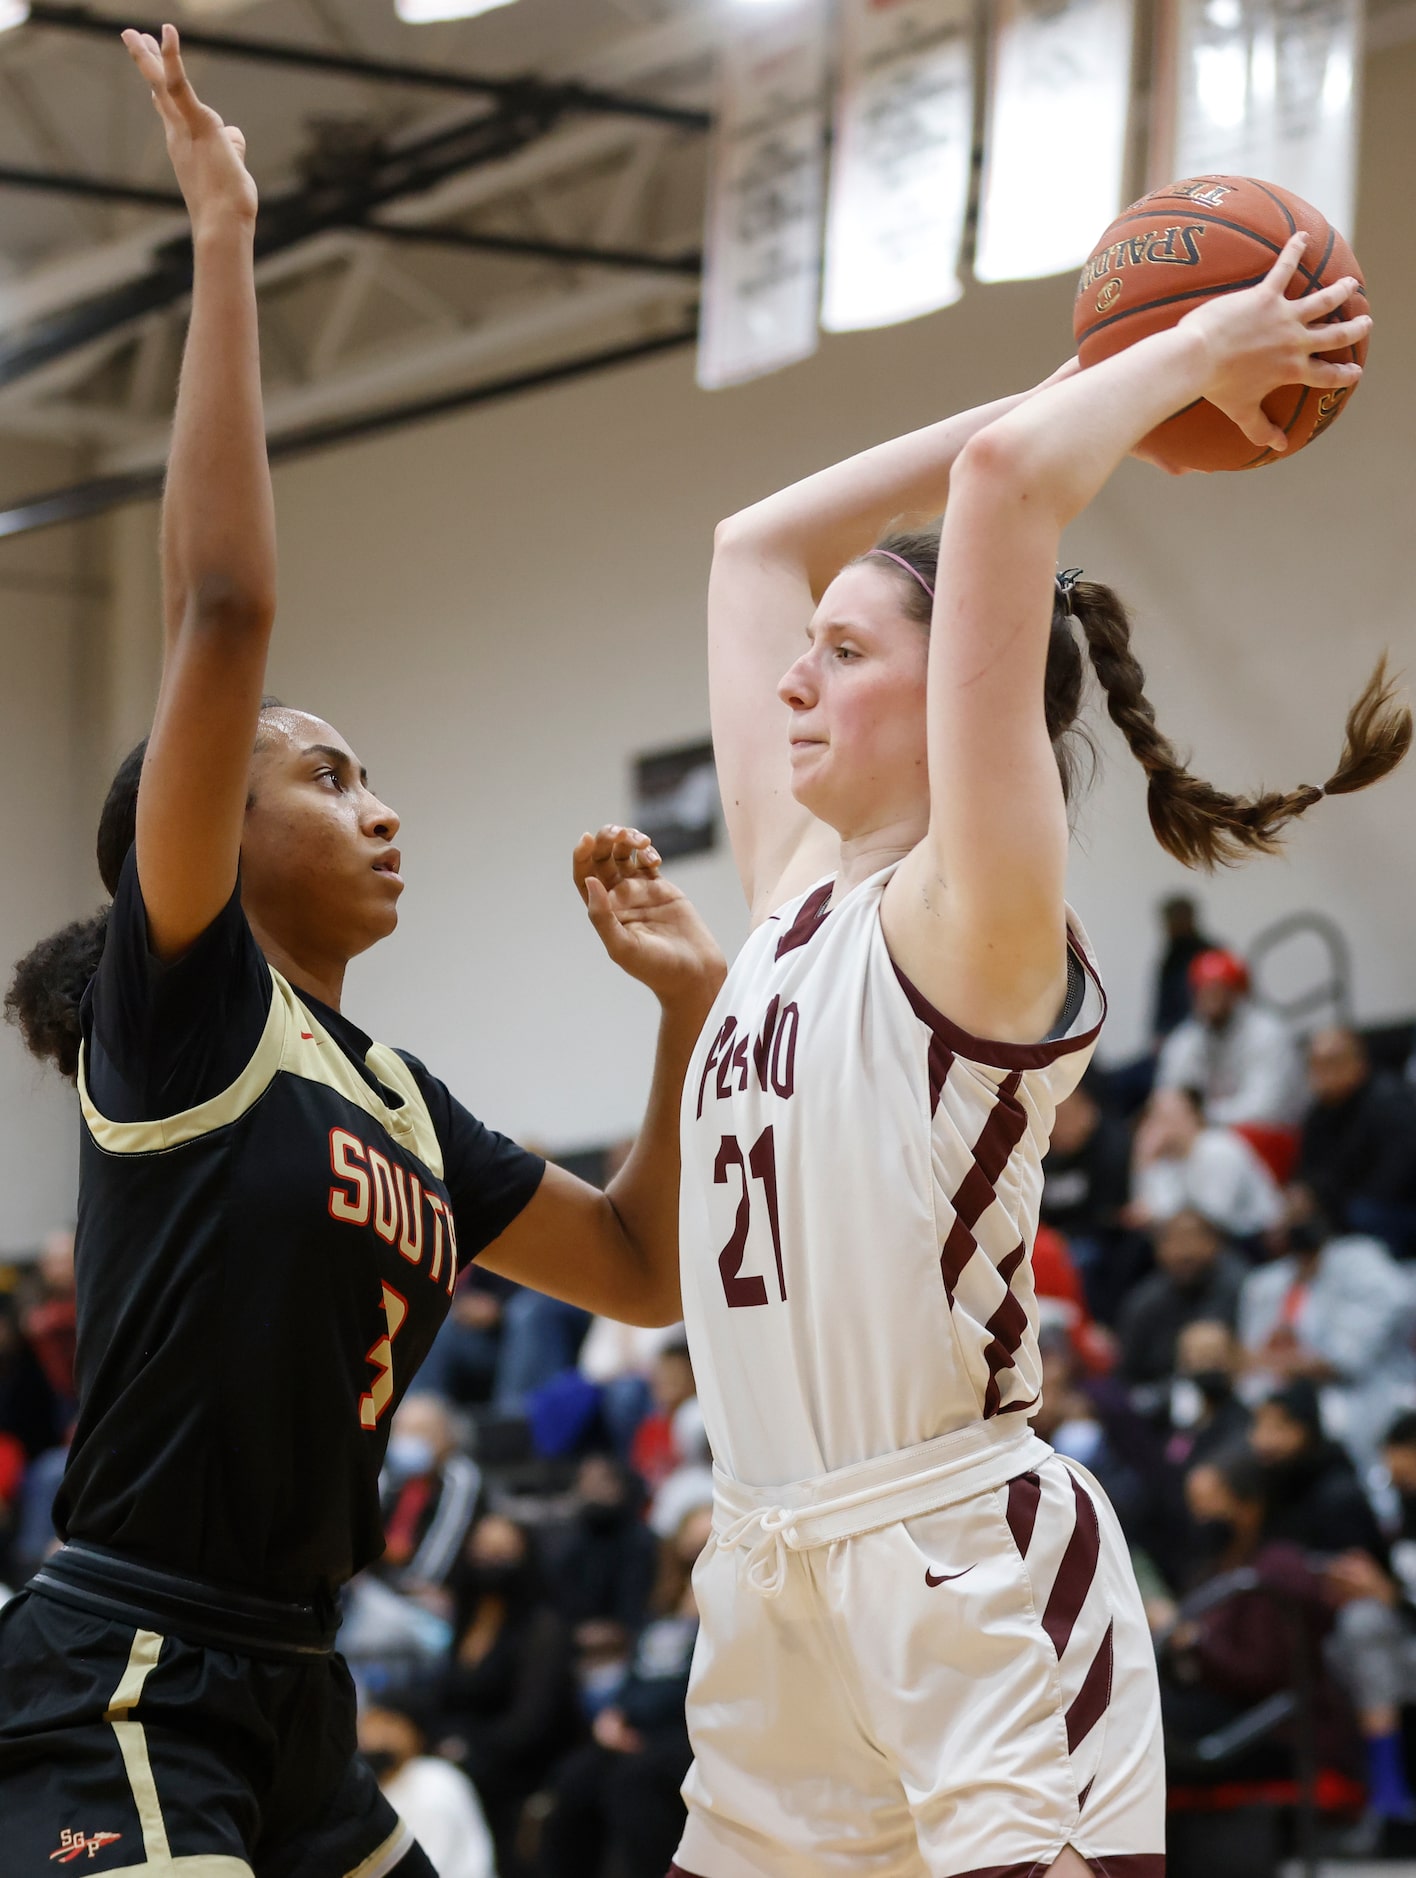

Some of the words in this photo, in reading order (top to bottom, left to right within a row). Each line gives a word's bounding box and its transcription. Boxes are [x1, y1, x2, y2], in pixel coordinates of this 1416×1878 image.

[713, 1123, 787, 1307] 21
[358, 1278, 409, 1430] 3
[60, 1827, 101, 1858] SGP
